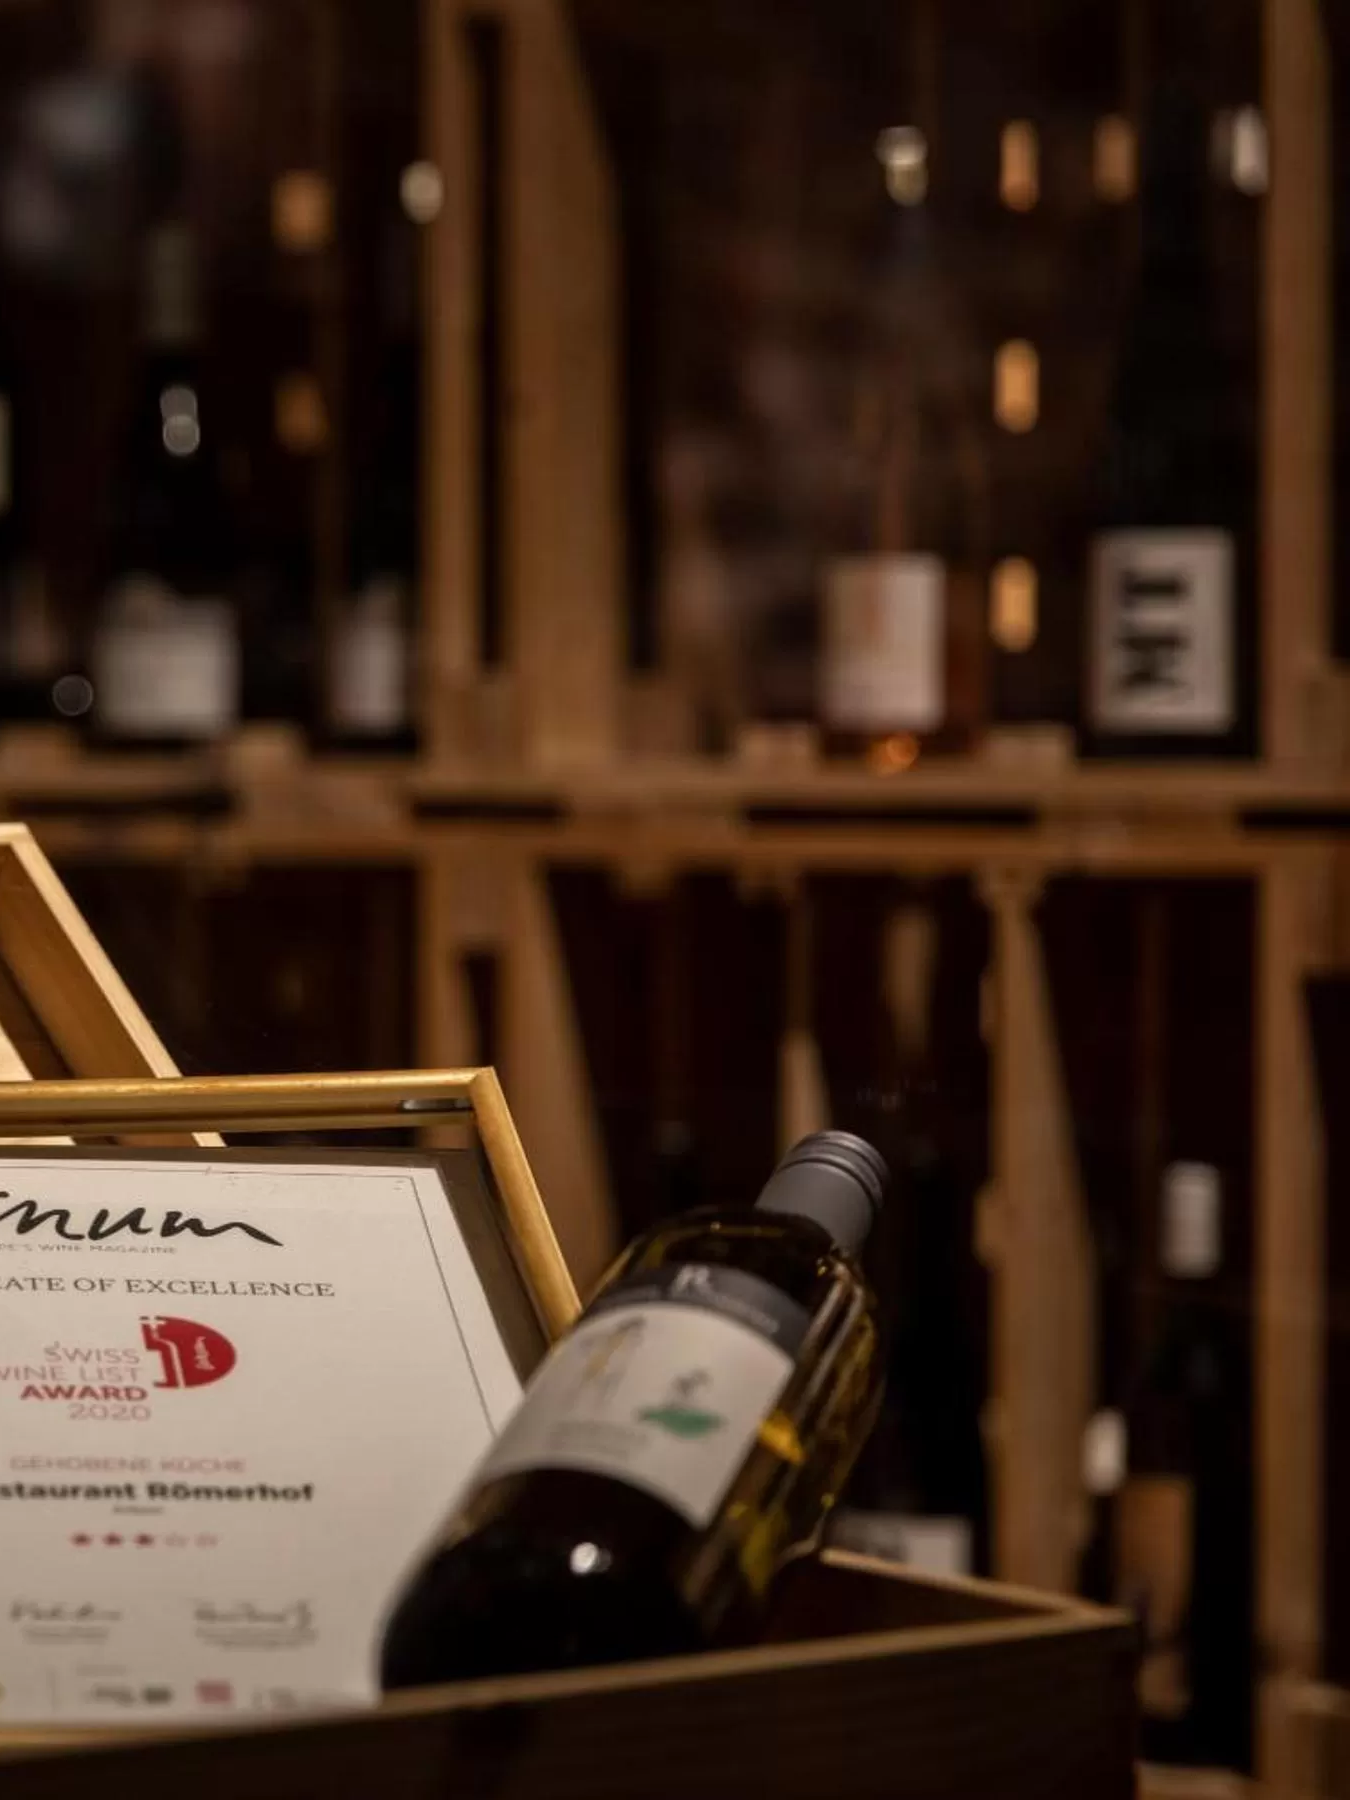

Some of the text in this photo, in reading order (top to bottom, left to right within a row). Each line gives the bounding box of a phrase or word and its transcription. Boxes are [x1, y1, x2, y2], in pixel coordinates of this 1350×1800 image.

[73, 1277, 114, 1292] OF
[125, 1278, 336, 1297] EXCELLENCE
[42, 1344, 141, 1364] SWISS
[80, 1366, 142, 1383] LIST
[19, 1384, 149, 1401] AWARD
[67, 1403, 151, 1421] 2020
[10, 1456, 151, 1473] GEHOBENE
[146, 1481, 314, 1501] Römerhof
